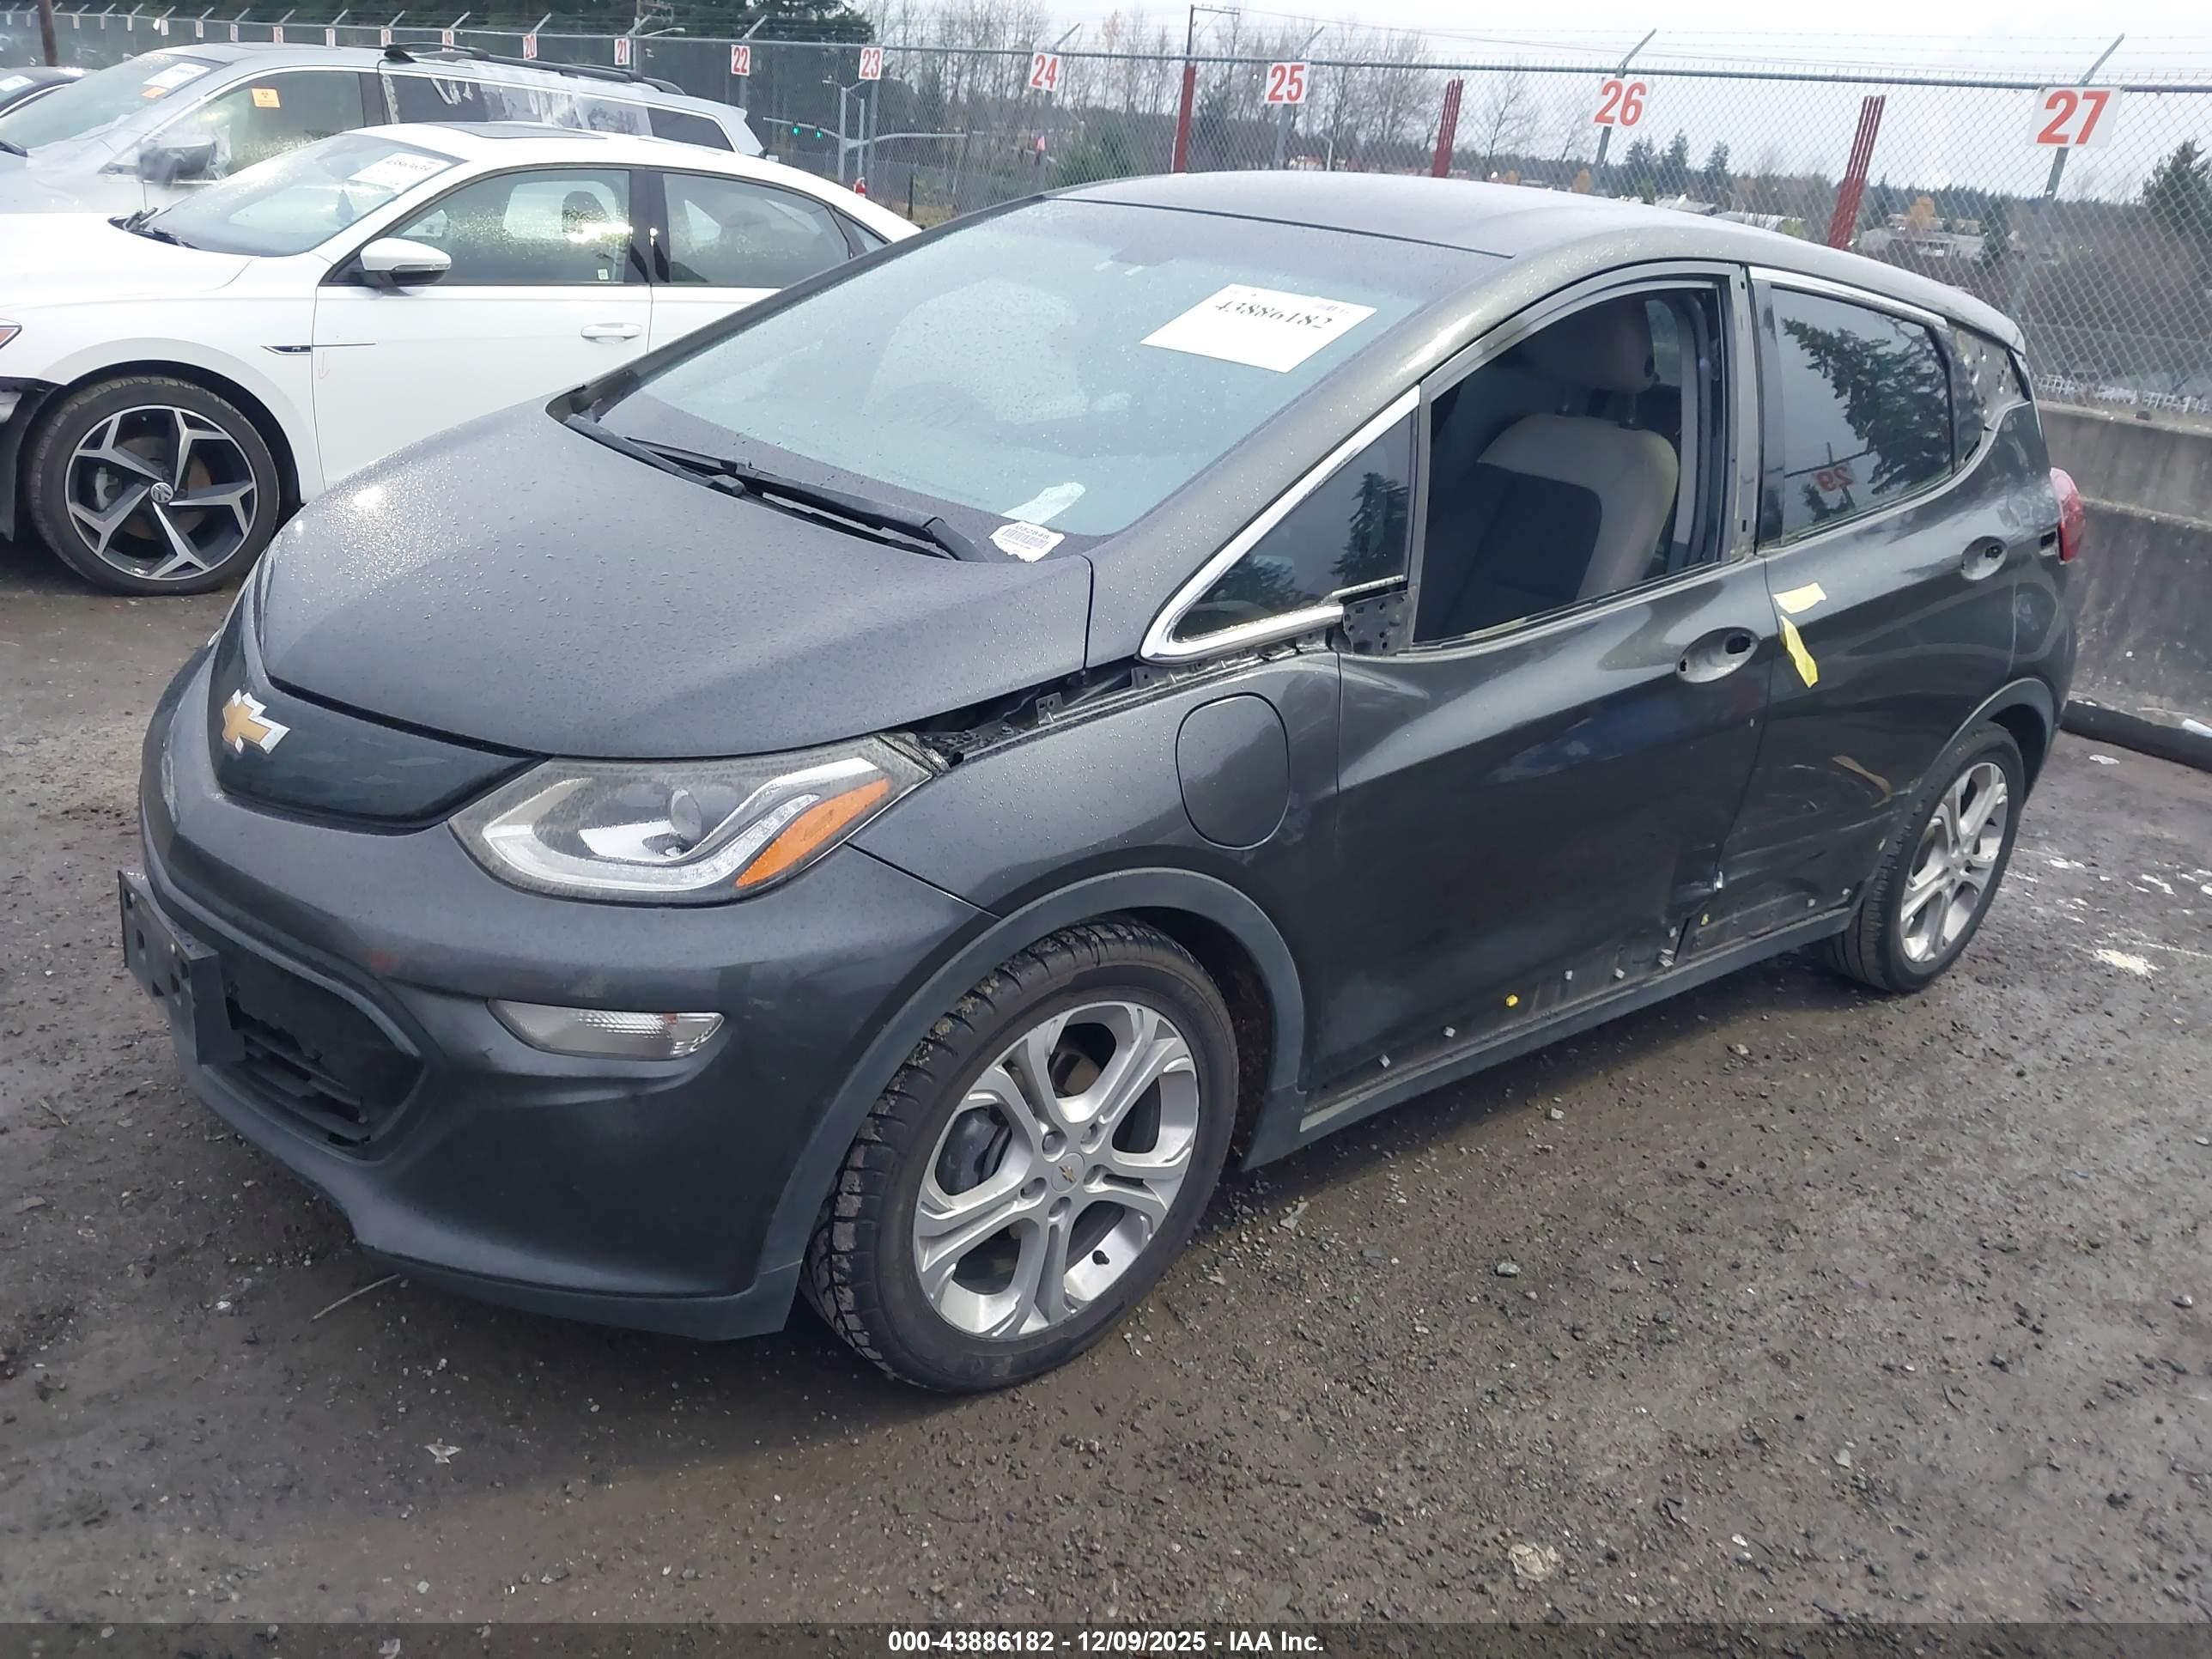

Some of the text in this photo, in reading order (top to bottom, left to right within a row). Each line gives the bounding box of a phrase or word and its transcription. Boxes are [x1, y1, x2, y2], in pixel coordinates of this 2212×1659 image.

[525, 35, 536, 58] 20
[617, 40, 627, 64] 21
[733, 46, 748, 74] 22
[860, 49, 880, 77] 23
[1030, 54, 1058, 88] 24
[1267, 64, 1305, 103] 25
[1594, 79, 1647, 127] 26
[2035, 89, 2112, 146] 27
